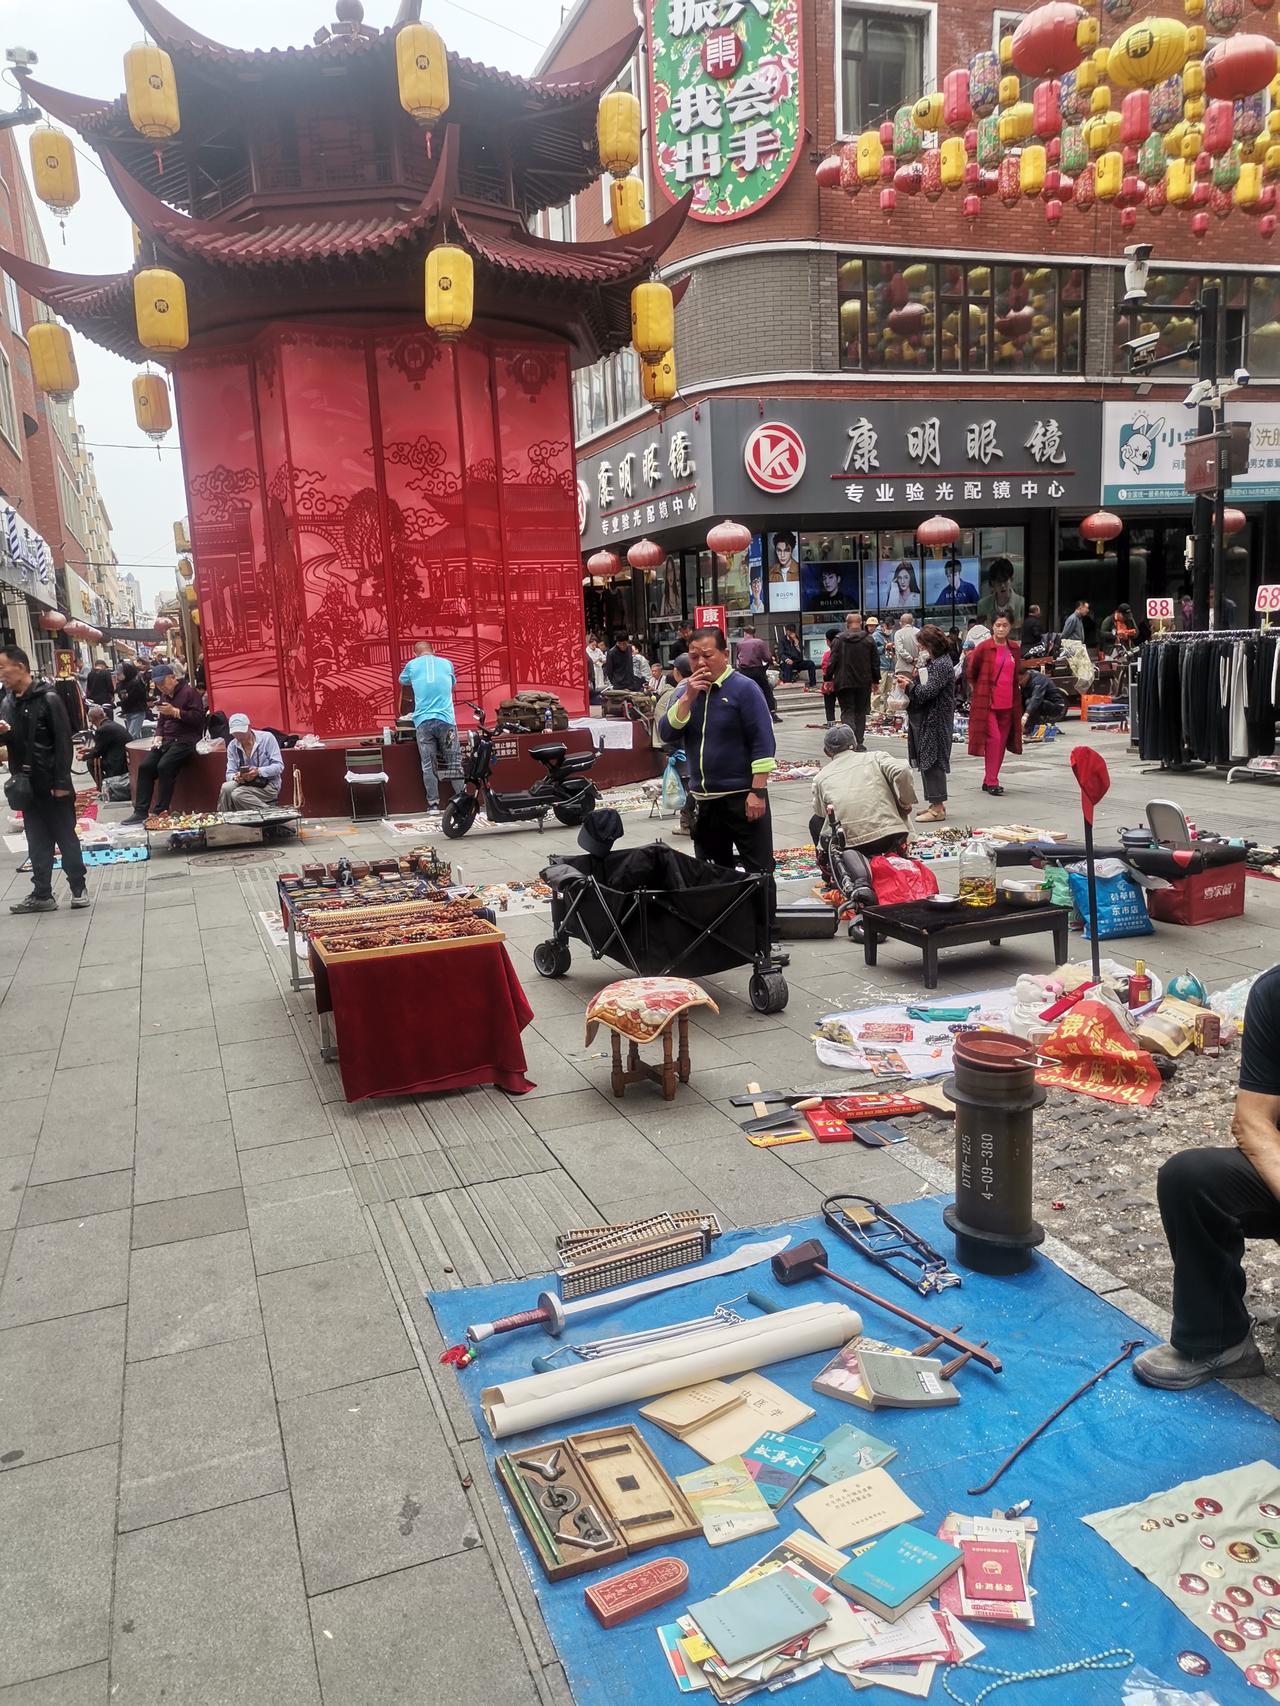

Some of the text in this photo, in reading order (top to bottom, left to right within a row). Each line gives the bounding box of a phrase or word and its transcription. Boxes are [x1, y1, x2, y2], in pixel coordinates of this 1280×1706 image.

[671, 74, 776, 135] 我会
[674, 120, 783, 182] 出手
[598, 431, 697, 509] 康明眼镜
[843, 417, 1067, 473] 康明眼镜
[601, 492, 697, 536] 专业验光配镜中心
[844, 481, 1066, 503] 专业验光配镜中心
[1148, 599, 1169, 617] 88
[1257, 587, 1280, 609] 68
[980, 1133, 994, 1201] 4-09-380
[753, 1443, 806, 1468] 故事会
